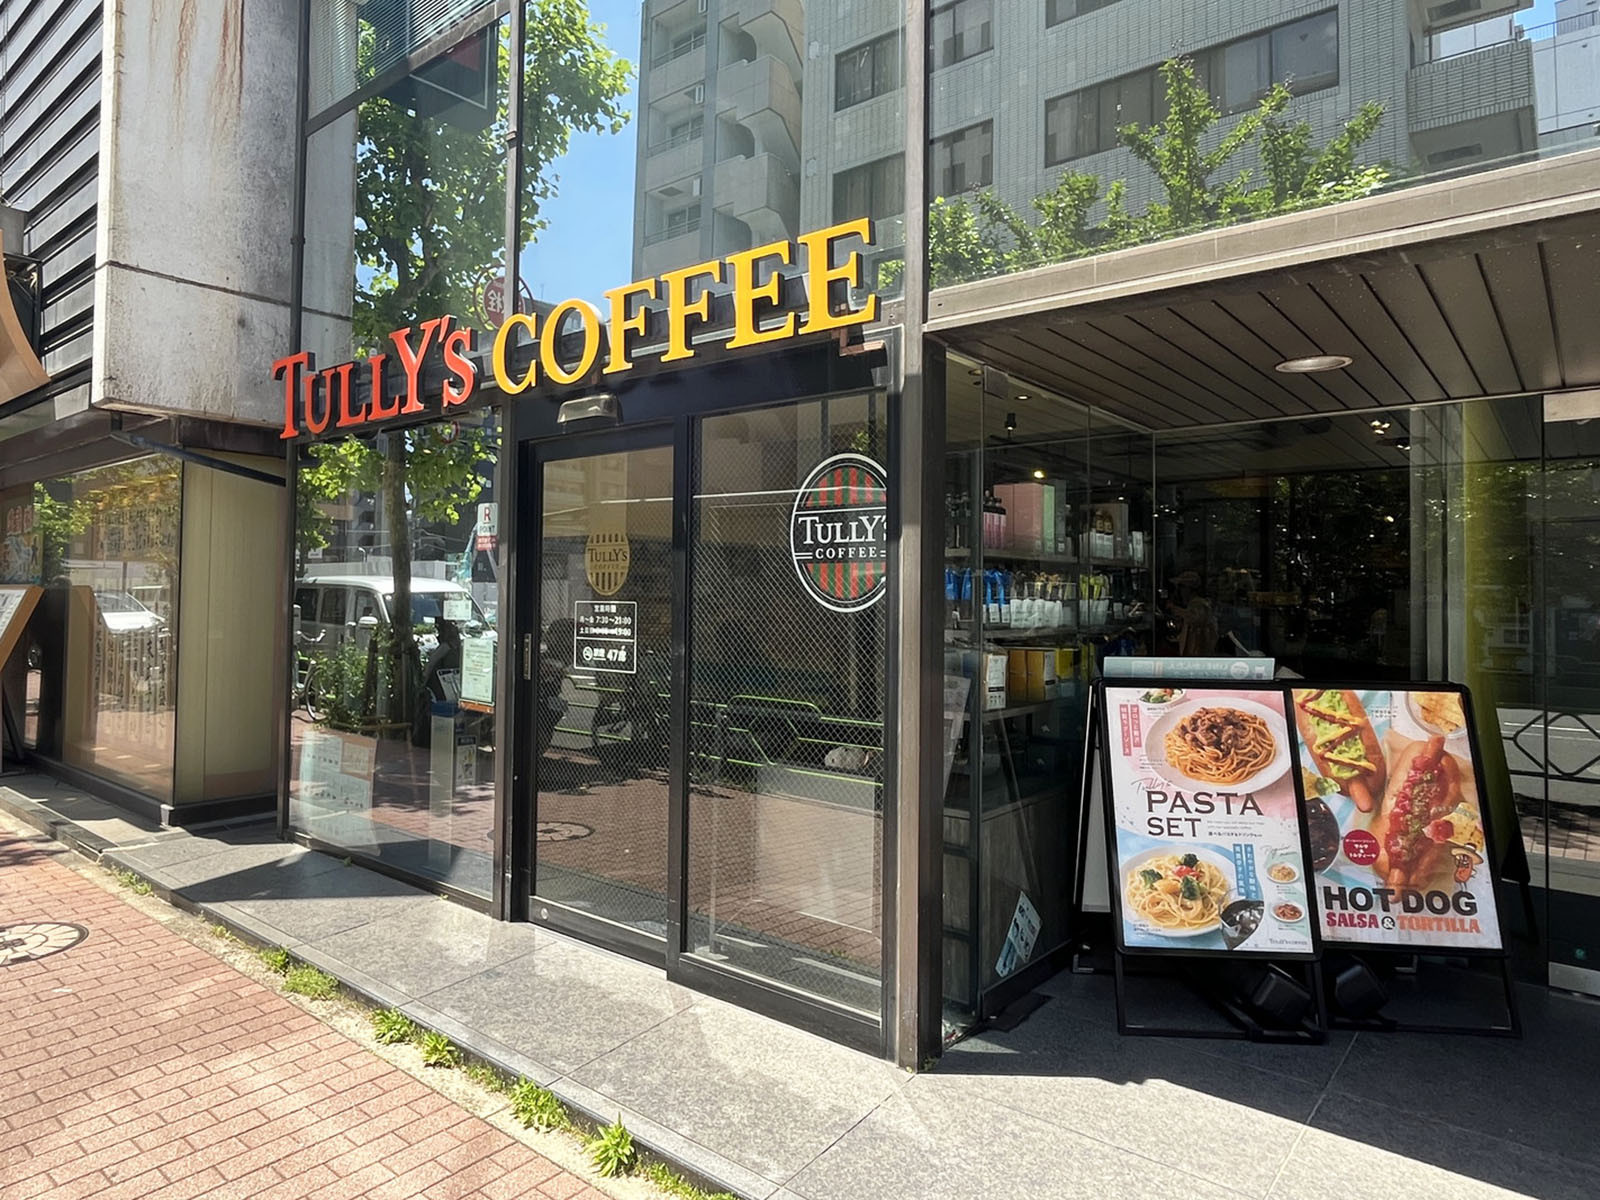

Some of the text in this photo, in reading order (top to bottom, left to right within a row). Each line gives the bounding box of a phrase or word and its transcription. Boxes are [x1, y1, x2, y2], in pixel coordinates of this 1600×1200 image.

[492, 217, 877, 394] COFFEE
[815, 547, 878, 559] COFFEE
[1146, 790, 1264, 816] PASTA
[1147, 817, 1202, 837] SET
[1323, 886, 1478, 916] HOT DOG
[1326, 912, 1480, 933] SALSA & TORTILLA
